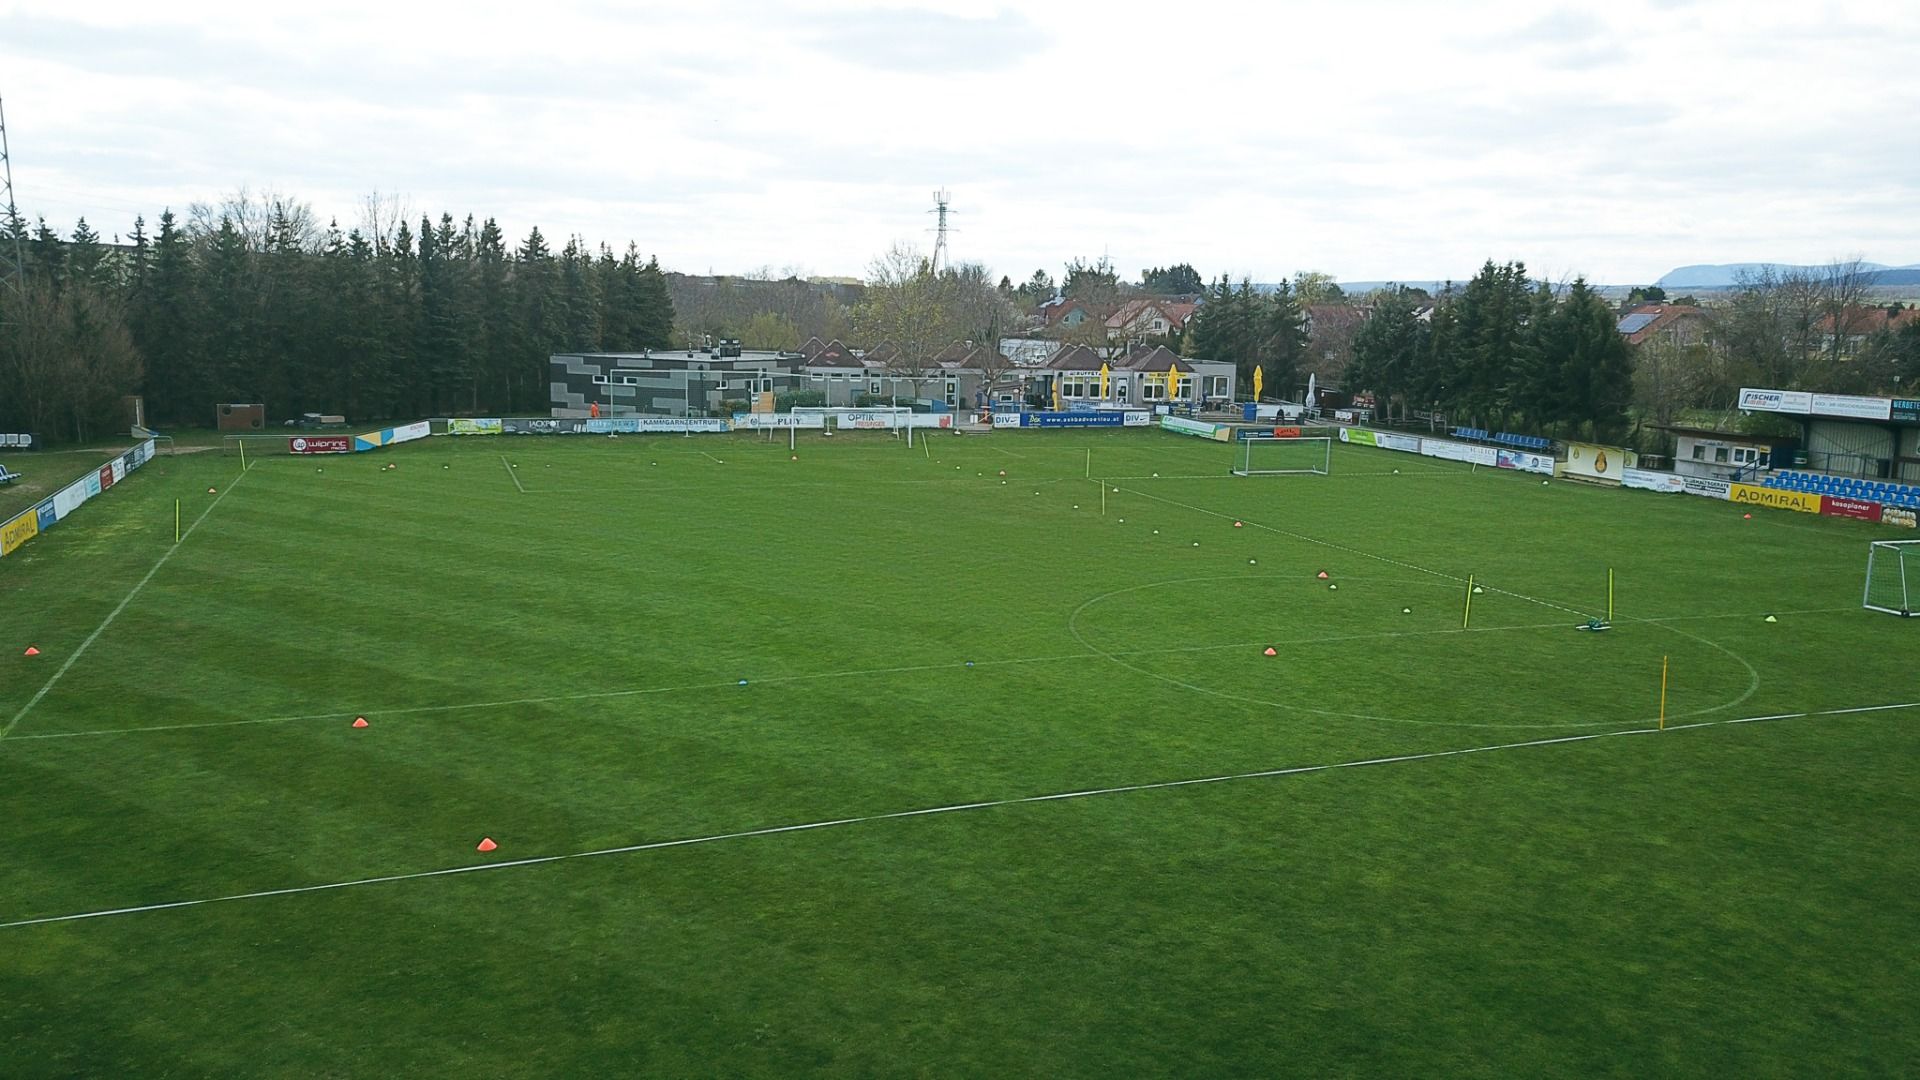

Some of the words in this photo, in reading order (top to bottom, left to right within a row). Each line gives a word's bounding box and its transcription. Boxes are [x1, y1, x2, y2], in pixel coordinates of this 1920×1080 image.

[1744, 393, 1780, 404] FISCHER
[847, 413, 874, 421] OPTIK
[529, 420, 560, 428] JACKPOT
[1735, 488, 1812, 511] ADMIRAL
[5, 517, 34, 544] ADMIRAL
